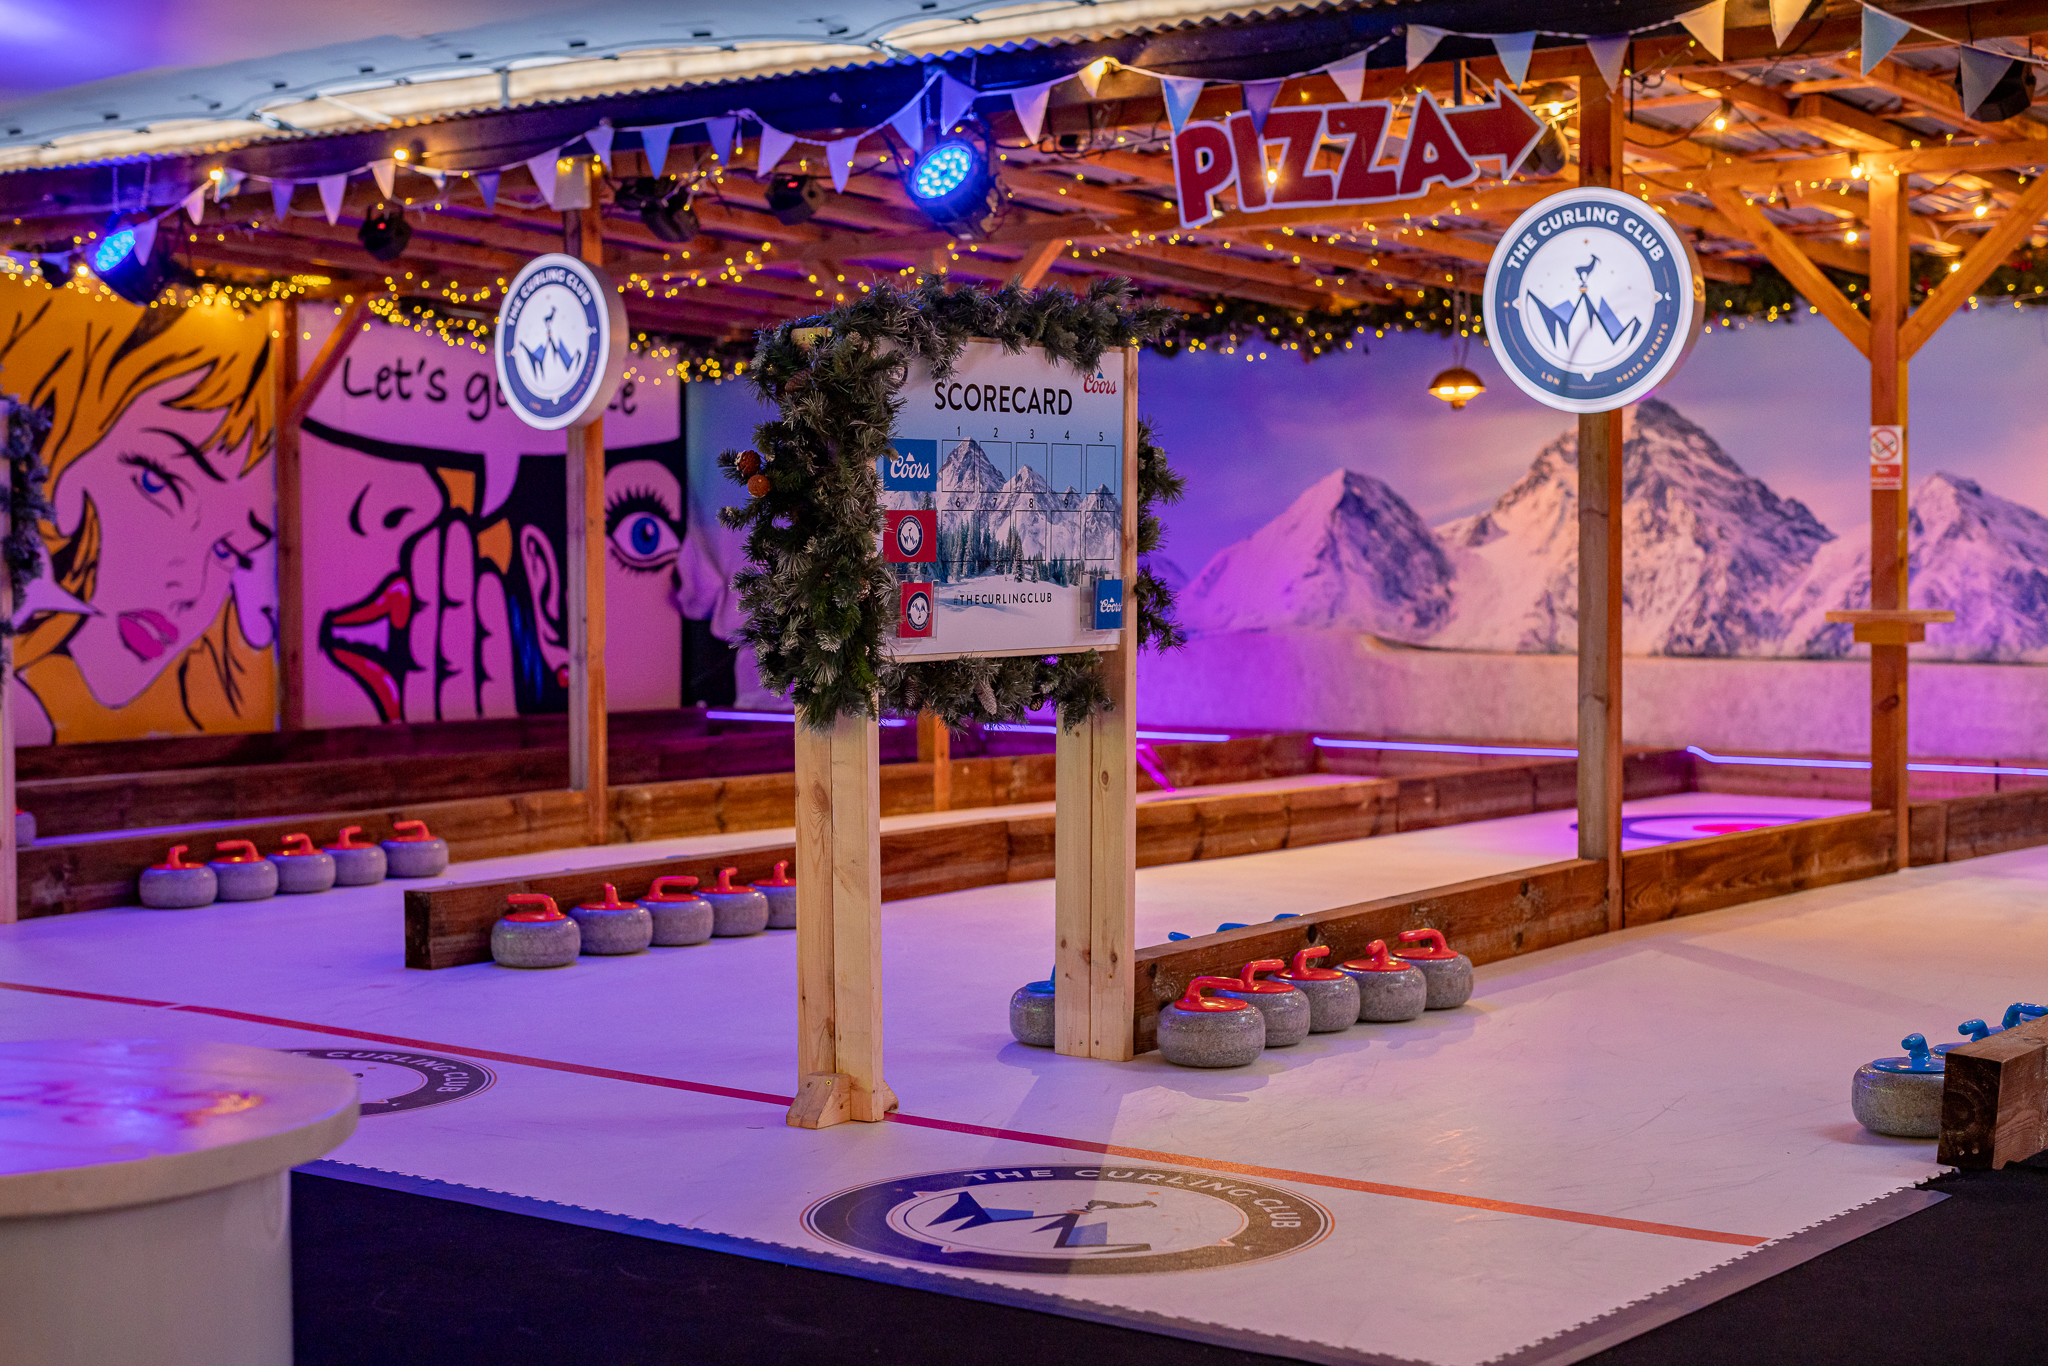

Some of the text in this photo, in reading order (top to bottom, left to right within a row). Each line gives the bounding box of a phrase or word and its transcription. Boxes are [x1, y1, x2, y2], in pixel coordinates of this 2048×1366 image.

[1172, 89, 1480, 229] PIZZA
[1506, 206, 1665, 270] THE CURLING CLUB
[506, 268, 592, 326] THE CURLING CLUB
[1643, 323, 1669, 362] EVENTS
[342, 356, 447, 401] Let's
[1083, 372, 1117, 395] Coors
[934, 382, 1073, 416] SCORECARD
[993, 427, 999, 438] 2
[1029, 429, 1035, 439] 3
[1064, 430, 1070, 440] 4
[1098, 431, 1104, 442] 5
[890, 455, 931, 479] Coors
[955, 497, 1105, 509] 6 7 8 9 10
[953, 592, 1053, 606] #THECURLINGCLUB
[326, 1051, 470, 1093] CURLING CLUB
[964, 1169, 1302, 1228] THE CURLING CLUB
